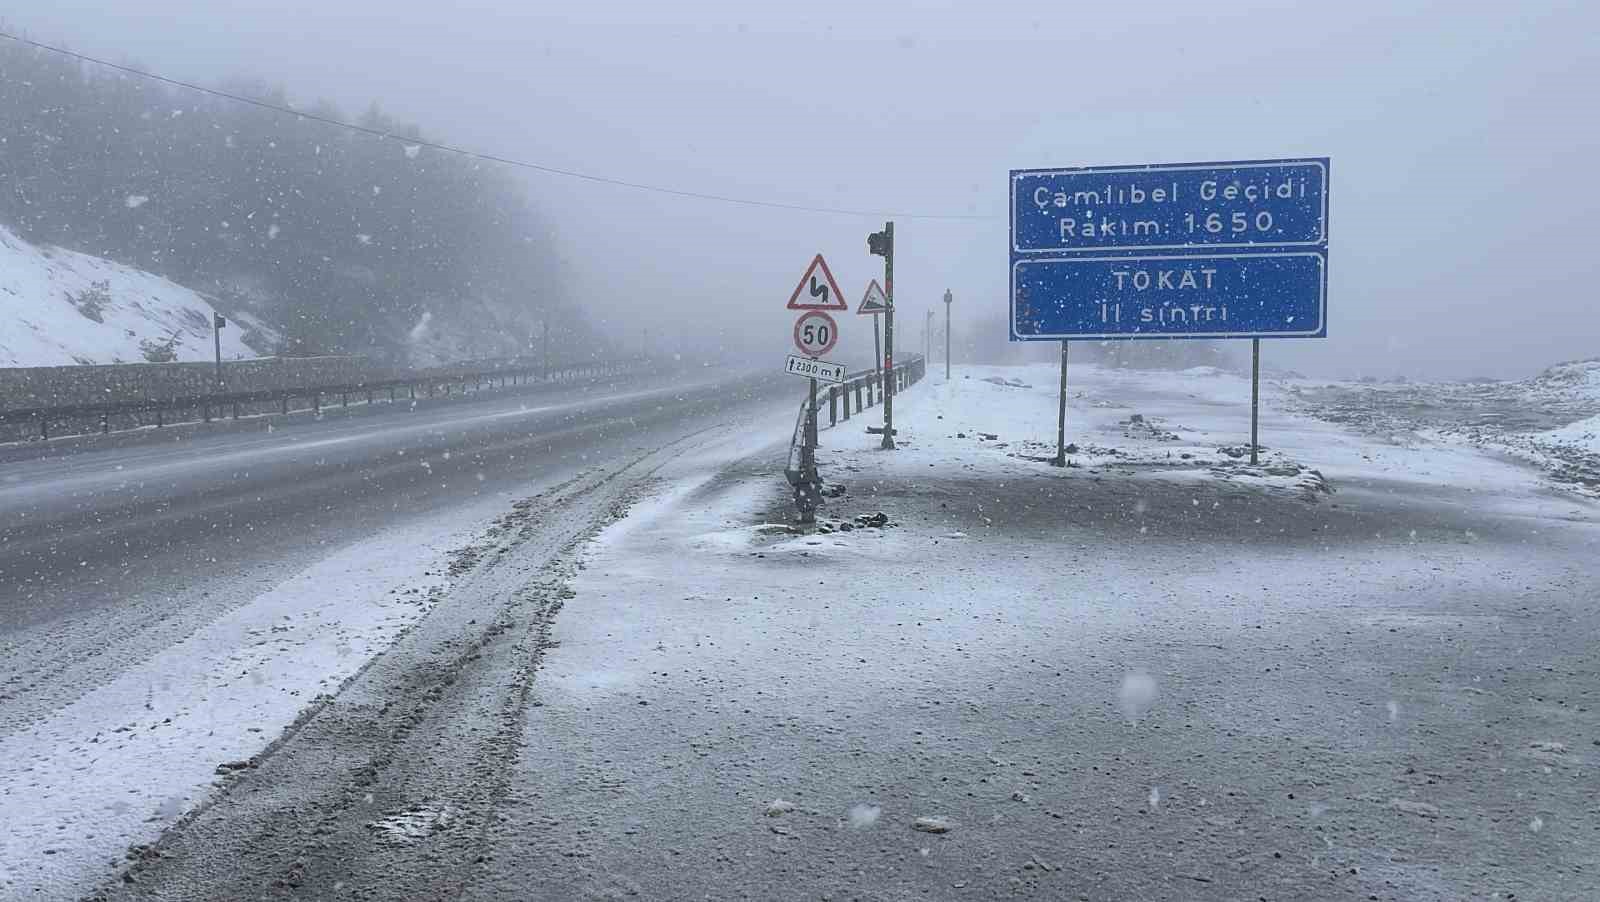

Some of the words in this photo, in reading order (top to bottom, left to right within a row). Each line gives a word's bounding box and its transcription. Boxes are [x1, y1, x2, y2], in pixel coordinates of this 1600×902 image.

[1033, 182, 1177, 209] Çamlıbel
[1200, 178, 1305, 202] Geçidi
[1185, 211, 1273, 233] 1650
[1112, 269, 1217, 291] TOKAT
[803, 325, 829, 345] 50
[796, 361, 818, 374] 2300
[821, 368, 832, 377] m
